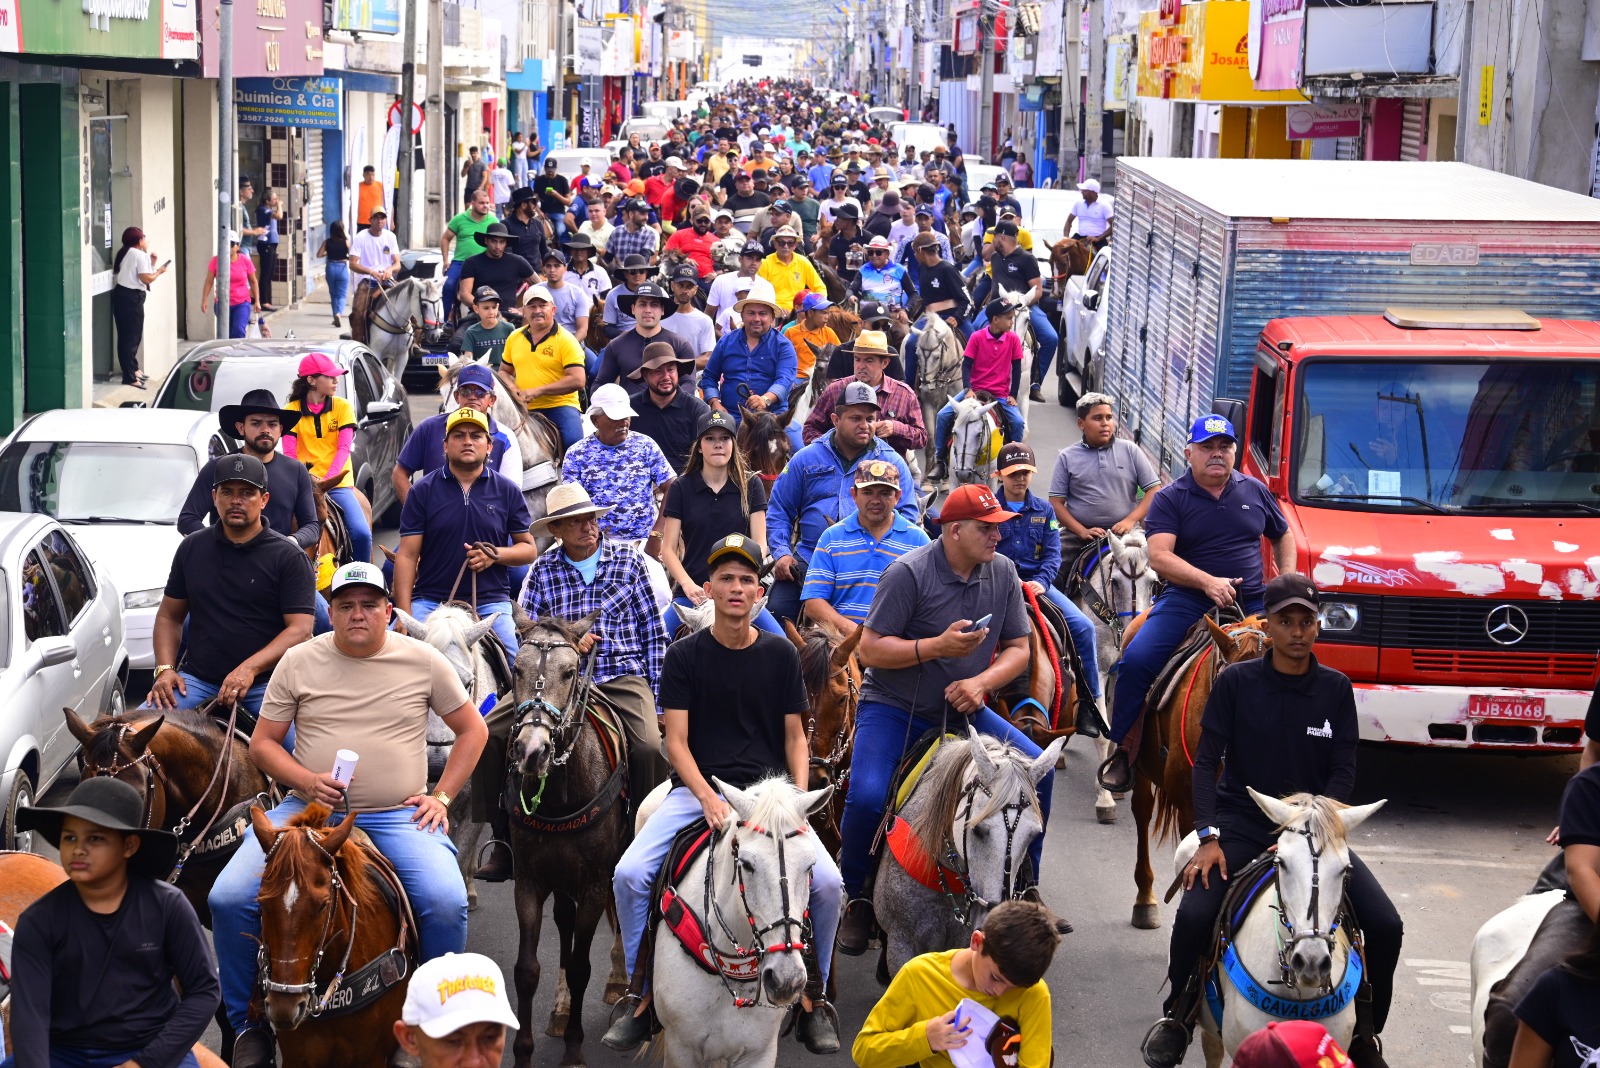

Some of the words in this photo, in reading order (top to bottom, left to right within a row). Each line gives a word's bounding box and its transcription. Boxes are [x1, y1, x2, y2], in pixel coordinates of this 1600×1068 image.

[235, 89, 292, 106] Química
[296, 93, 308, 107] &
[312, 94, 335, 108] Cia
[1414, 244, 1476, 261] EDARP
[523, 813, 587, 832] CAVALGADA
[194, 826, 236, 855] MACIEL
[436, 974, 497, 1006] THRASHER
[1261, 989, 1346, 1017] CAVALGADA
